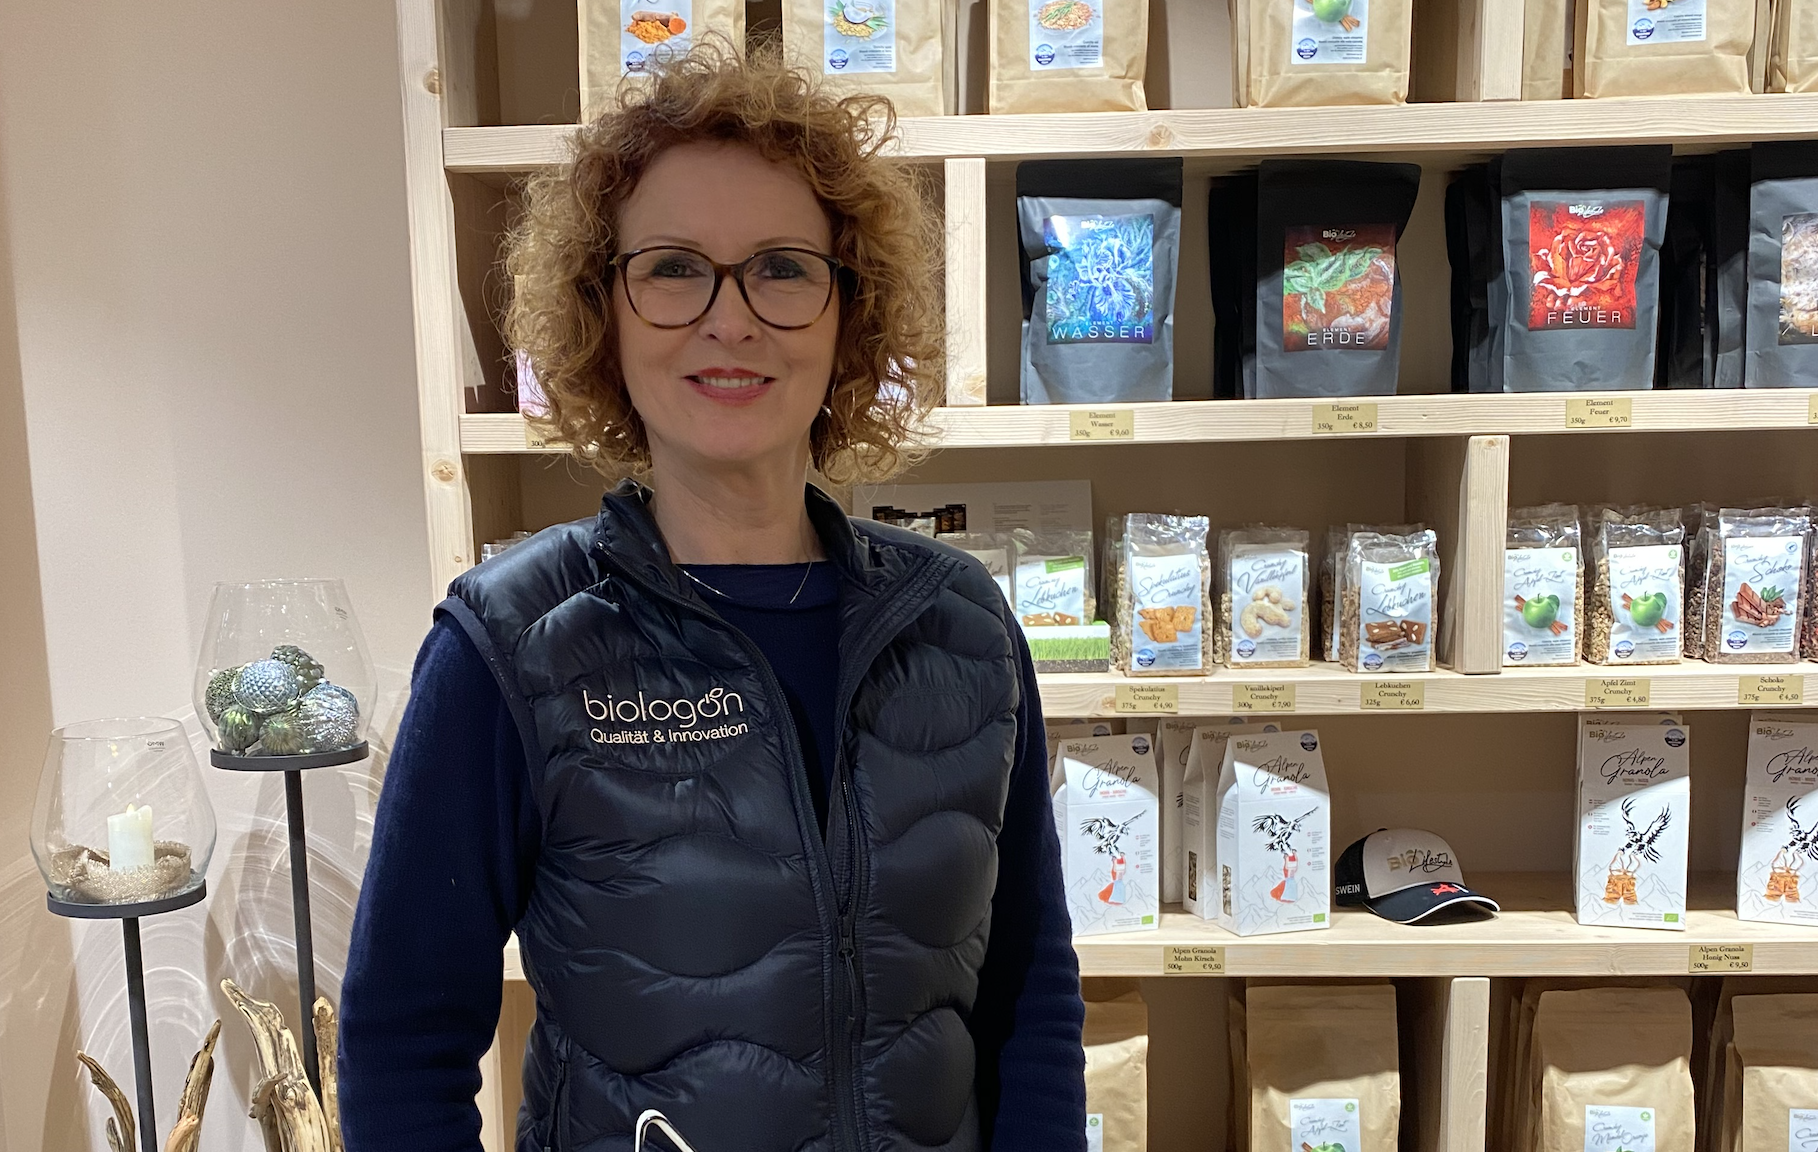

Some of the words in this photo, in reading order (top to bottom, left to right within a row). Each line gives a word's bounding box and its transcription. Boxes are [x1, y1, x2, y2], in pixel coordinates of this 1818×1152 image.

[1547, 311, 1621, 324] FEUER
[1052, 325, 1145, 339] WASSER
[1307, 332, 1365, 345] ERDE
[1133, 694, 1160, 702] Crunchy
[1378, 690, 1407, 698] Crunchy
[1757, 685, 1785, 693] Crunchy
[583, 687, 744, 728] biologon
[590, 728, 650, 744] Qualität
[653, 729, 665, 743] &
[668, 722, 748, 743] Innovation
[1265, 755, 1299, 774] Alpen
[1618, 748, 1657, 766] Alpen
[1785, 746, 1818, 765] Alp
[1095, 758, 1129, 777] Alpen
[1600, 755, 1670, 785] Granola
[1766, 752, 1818, 783] Grano
[1082, 766, 1141, 798] Granola
[1253, 762, 1311, 794] Granola
